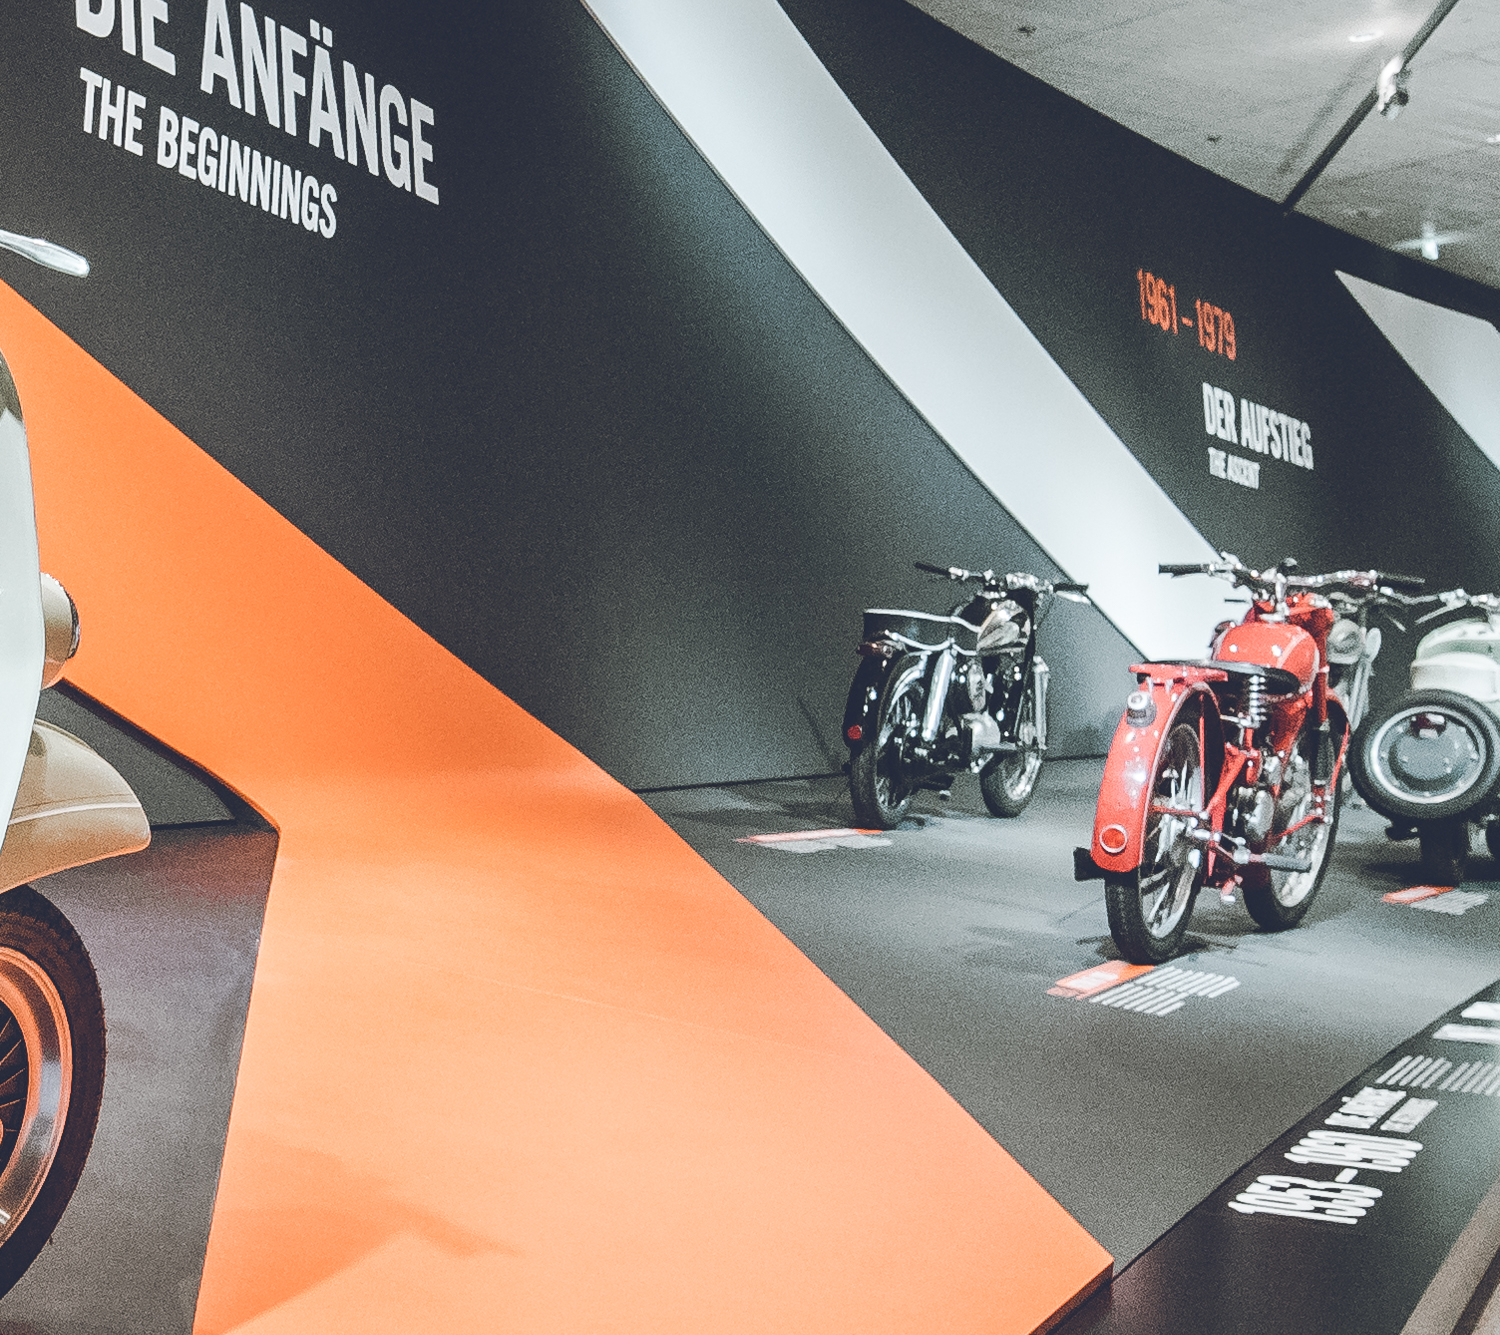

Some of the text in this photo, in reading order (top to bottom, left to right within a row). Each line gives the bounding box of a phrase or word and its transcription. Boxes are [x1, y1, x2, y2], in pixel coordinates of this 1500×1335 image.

[79, 66, 338, 239] THE BEGINNINGS
[1137, 268, 1178, 335] 1961
[1195, 298, 1237, 361] 1979
[1202, 381, 1314, 471] DER AUFSTIEG
